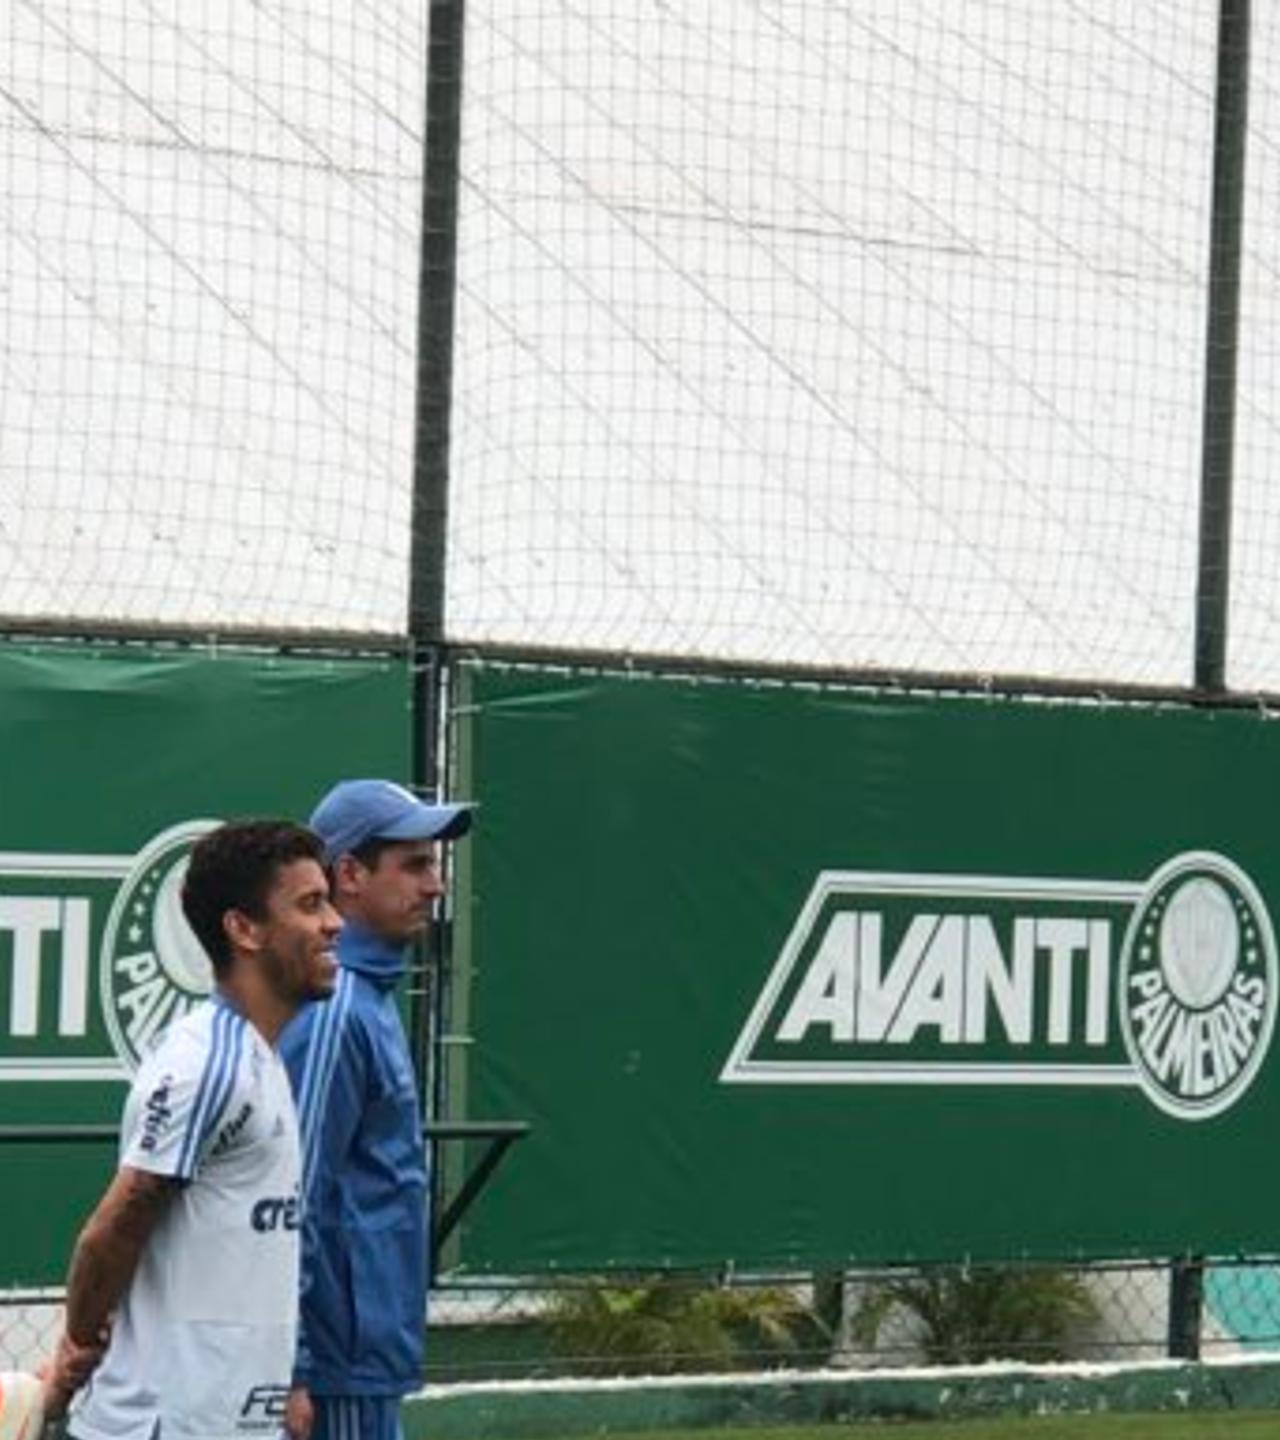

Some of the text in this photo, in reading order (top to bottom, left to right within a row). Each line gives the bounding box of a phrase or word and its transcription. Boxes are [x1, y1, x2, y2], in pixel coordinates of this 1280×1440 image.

[774, 910, 1111, 1045] AVANTI
[1129, 969, 1265, 1097] PALMEIRAS
[251, 1194, 300, 1233] cre
